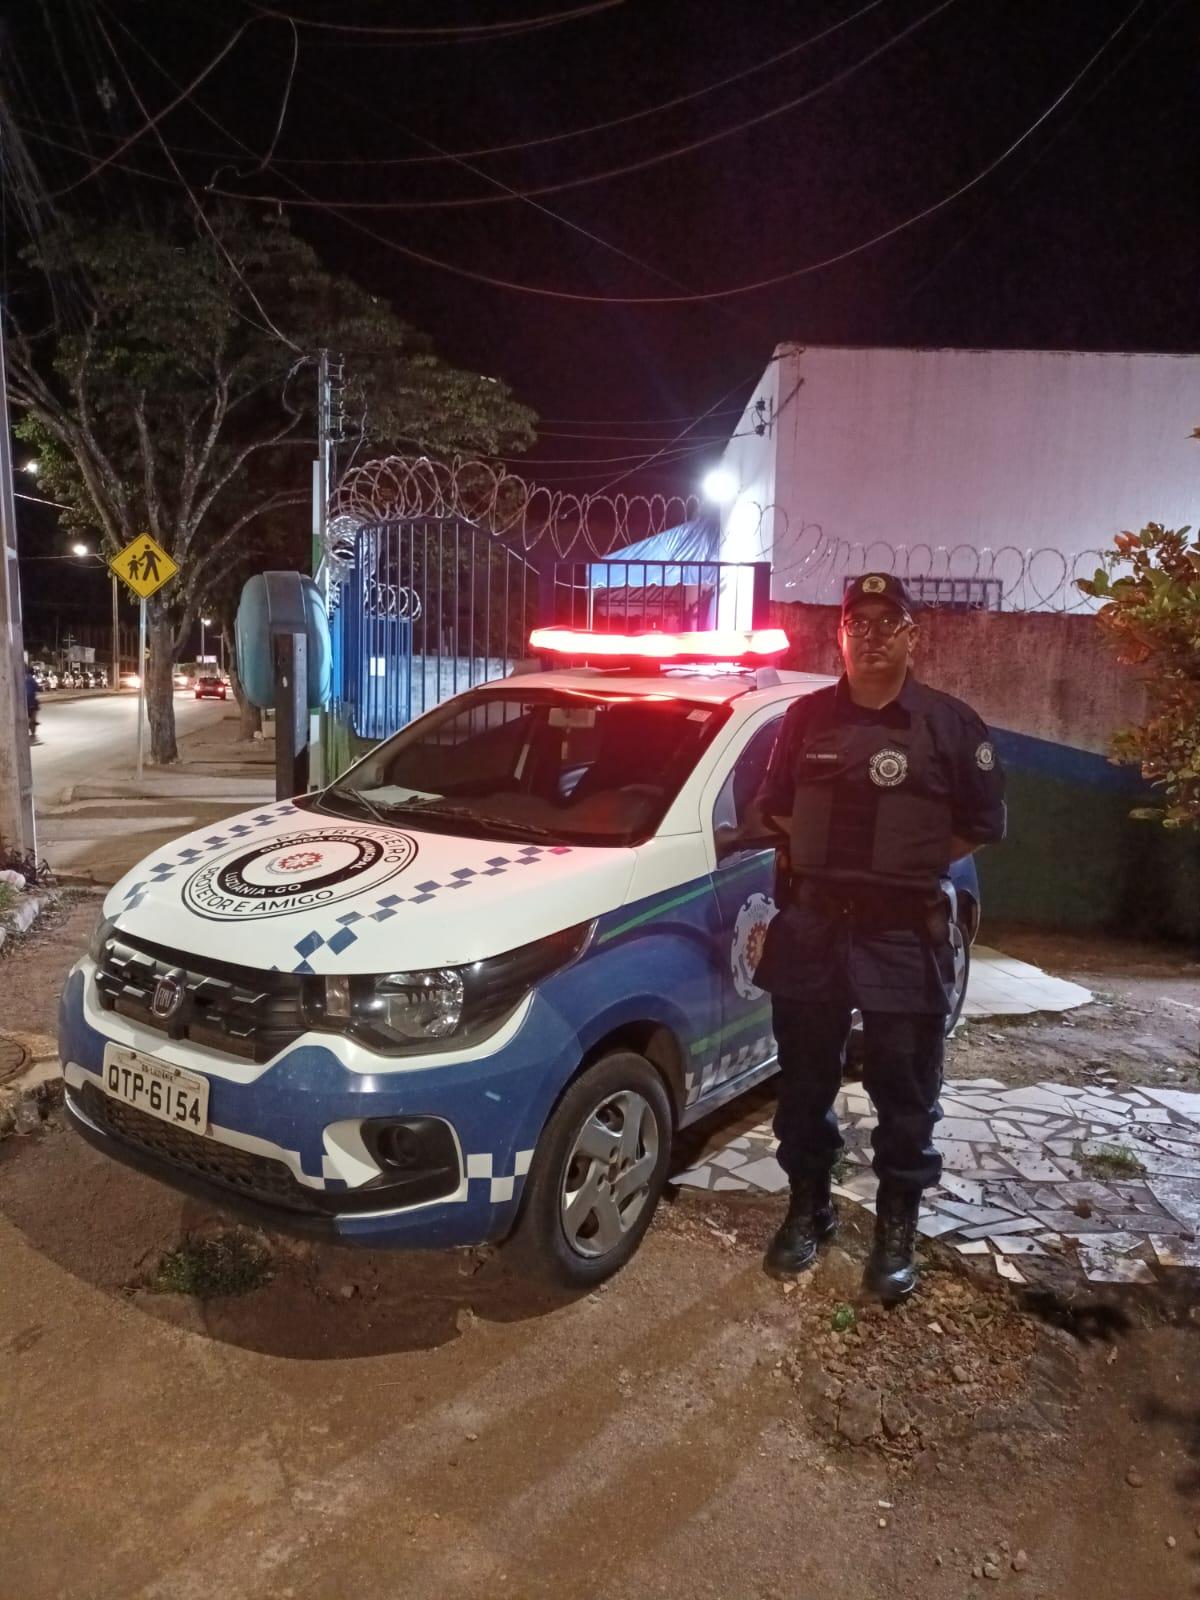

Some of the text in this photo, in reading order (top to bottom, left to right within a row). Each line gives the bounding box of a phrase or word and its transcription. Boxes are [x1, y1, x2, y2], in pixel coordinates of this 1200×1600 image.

[260, 837, 324, 853] GUARDA
[276, 829, 406, 863] PATRULHEIRO
[195, 866, 334, 912] PROTETOR E AMIGO
